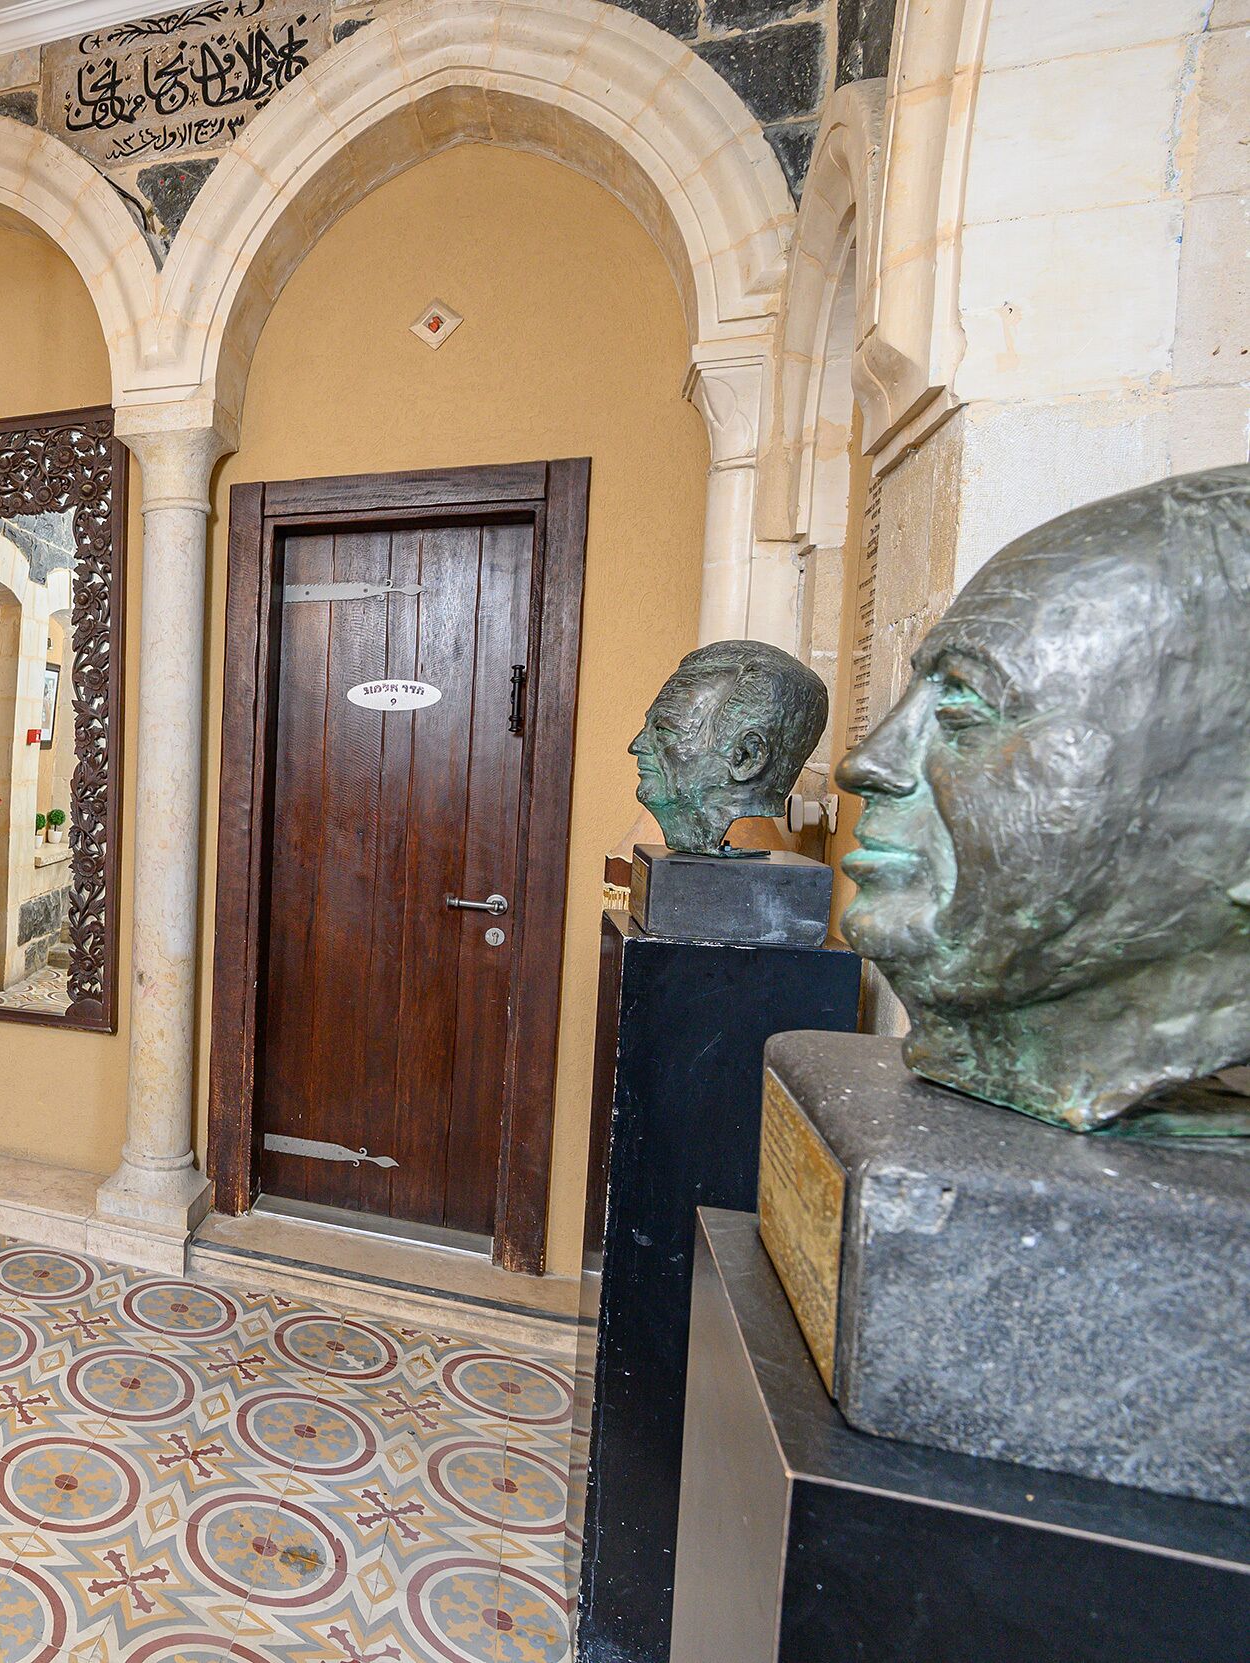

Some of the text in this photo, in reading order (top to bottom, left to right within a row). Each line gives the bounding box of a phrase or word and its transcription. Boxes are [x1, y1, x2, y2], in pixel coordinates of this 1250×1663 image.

[194, 117, 225, 144] ربيع
[402, 684, 425, 696] חדר
[390, 698, 397, 706] 9
